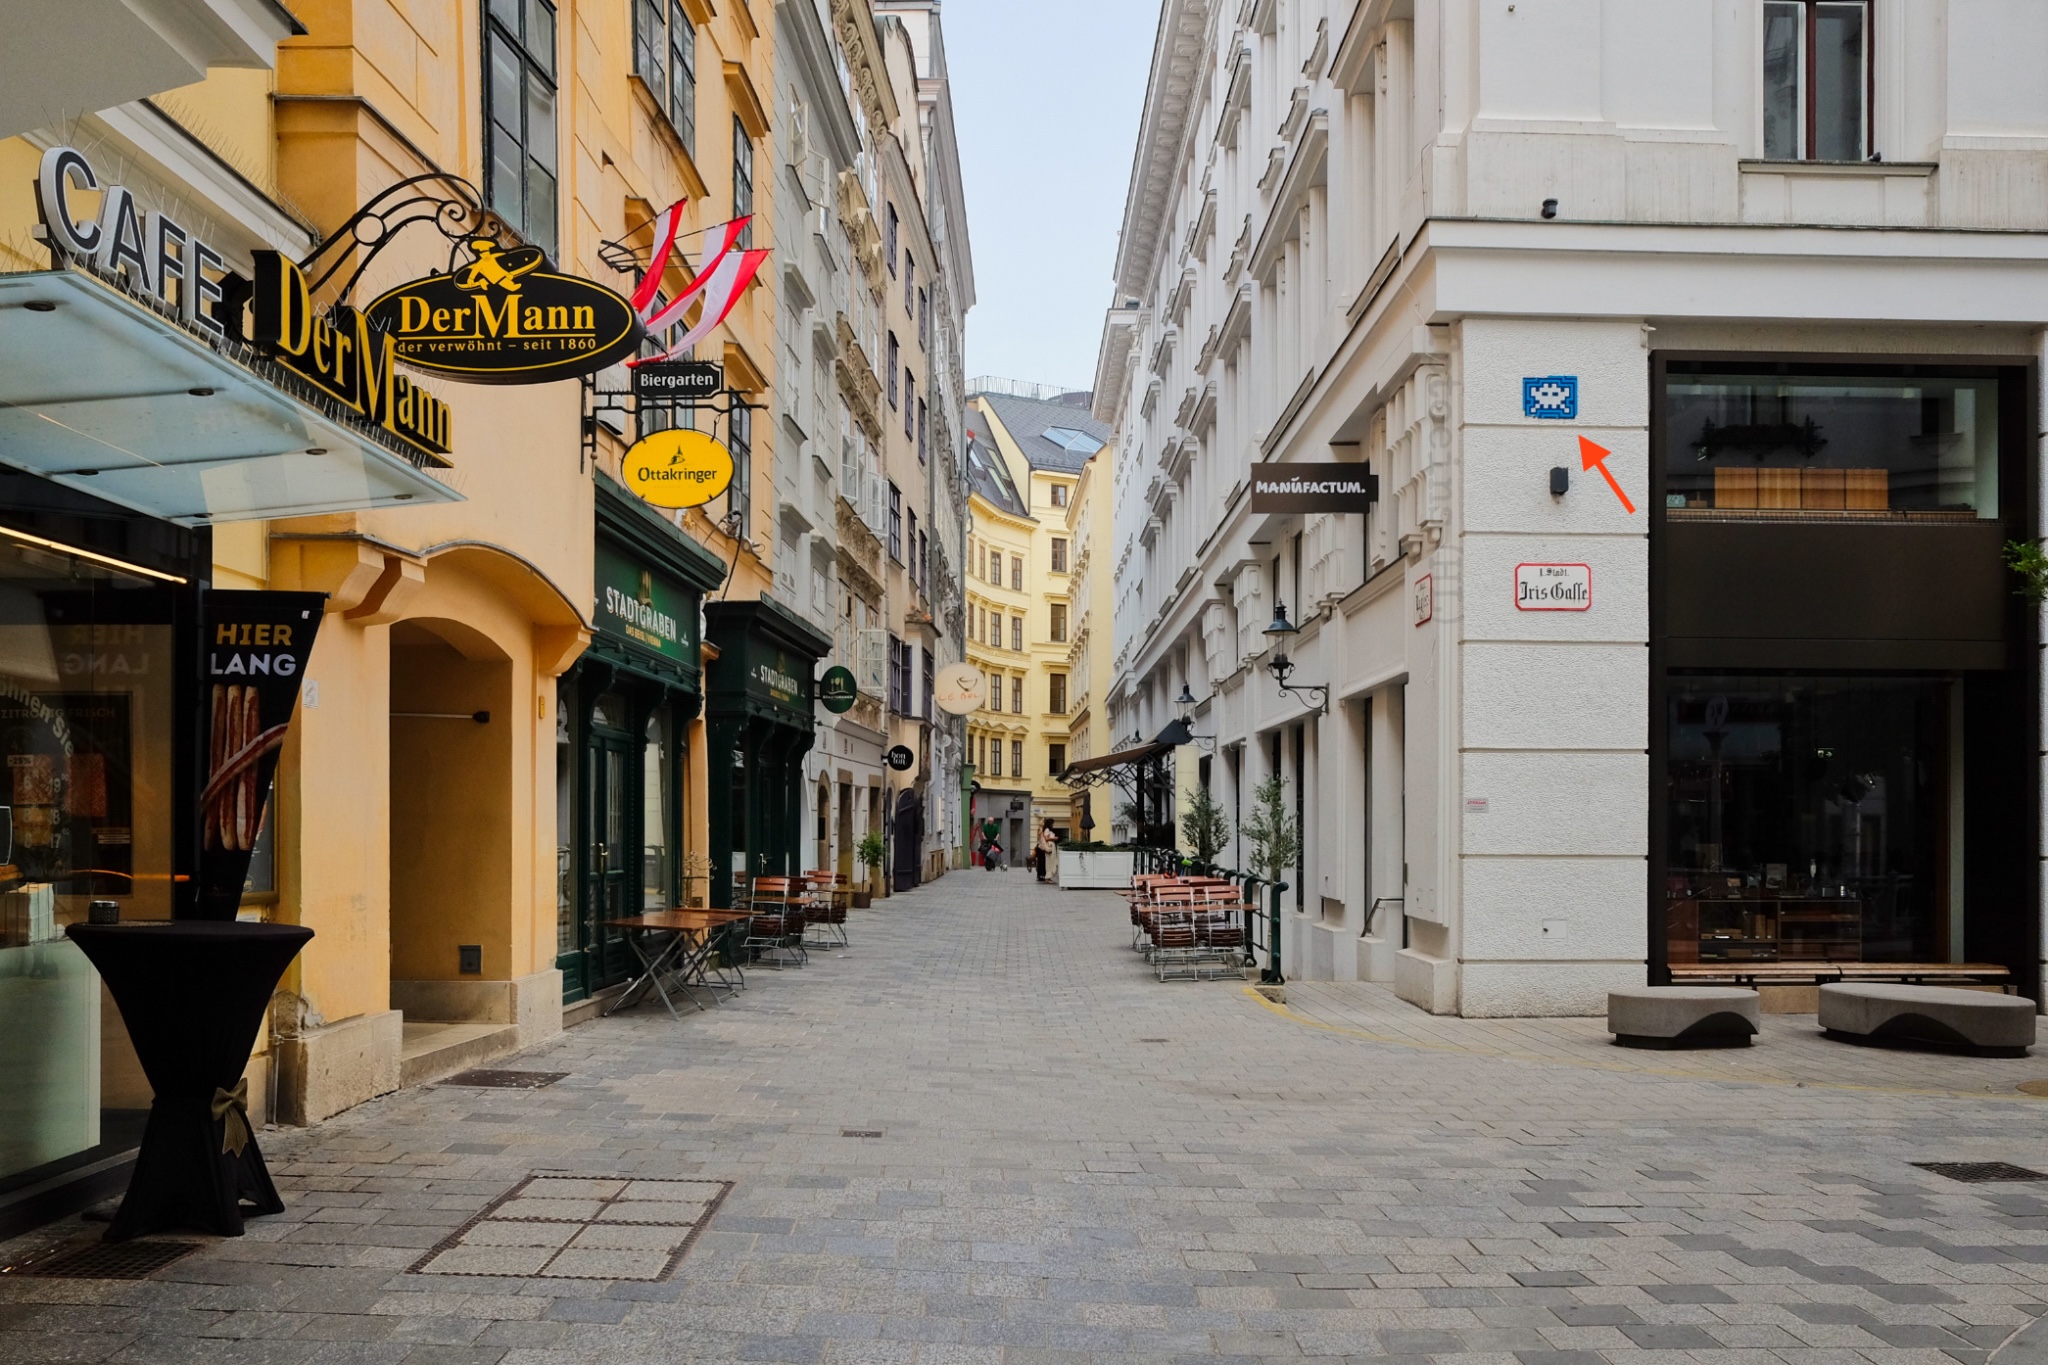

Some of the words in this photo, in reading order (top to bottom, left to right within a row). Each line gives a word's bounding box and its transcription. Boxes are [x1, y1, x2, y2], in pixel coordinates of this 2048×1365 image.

[39, 146, 225, 338] CAFE
[398, 342, 422, 353] der
[429, 340, 502, 352] verwöhnt
[523, 340, 552, 351] seit
[560, 338, 597, 350] 1860
[640, 373, 714, 389] Biergarten
[637, 467, 718, 483] Ottakringer
[606, 586, 677, 643] STADTGRABEN
[216, 623, 293, 646] HIER
[210, 652, 297, 677] LANG
[760, 664, 798, 696] STADTGRABEN
[1, 708, 65, 719] ZITROIG
[69, 707, 115, 719] FRISCH
